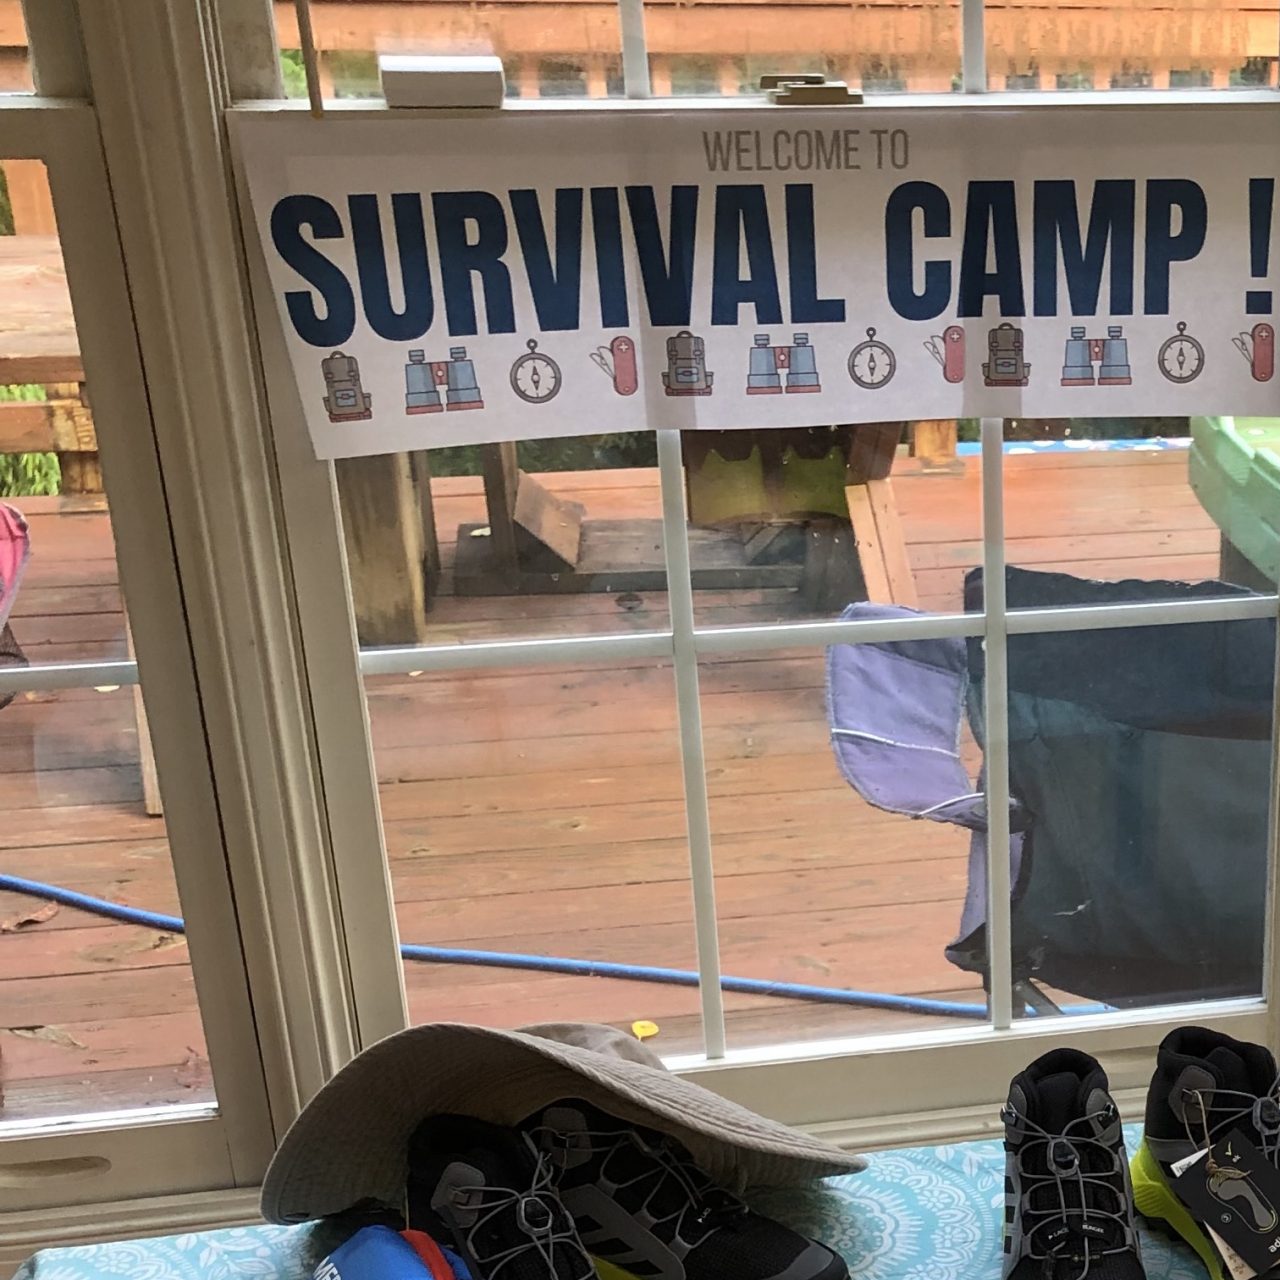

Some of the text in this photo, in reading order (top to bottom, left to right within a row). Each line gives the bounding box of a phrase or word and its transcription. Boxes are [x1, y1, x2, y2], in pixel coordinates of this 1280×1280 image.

[701, 128, 910, 173] WELCOME TO
[270, 177, 1276, 348] SURVIVAL CAMP !
